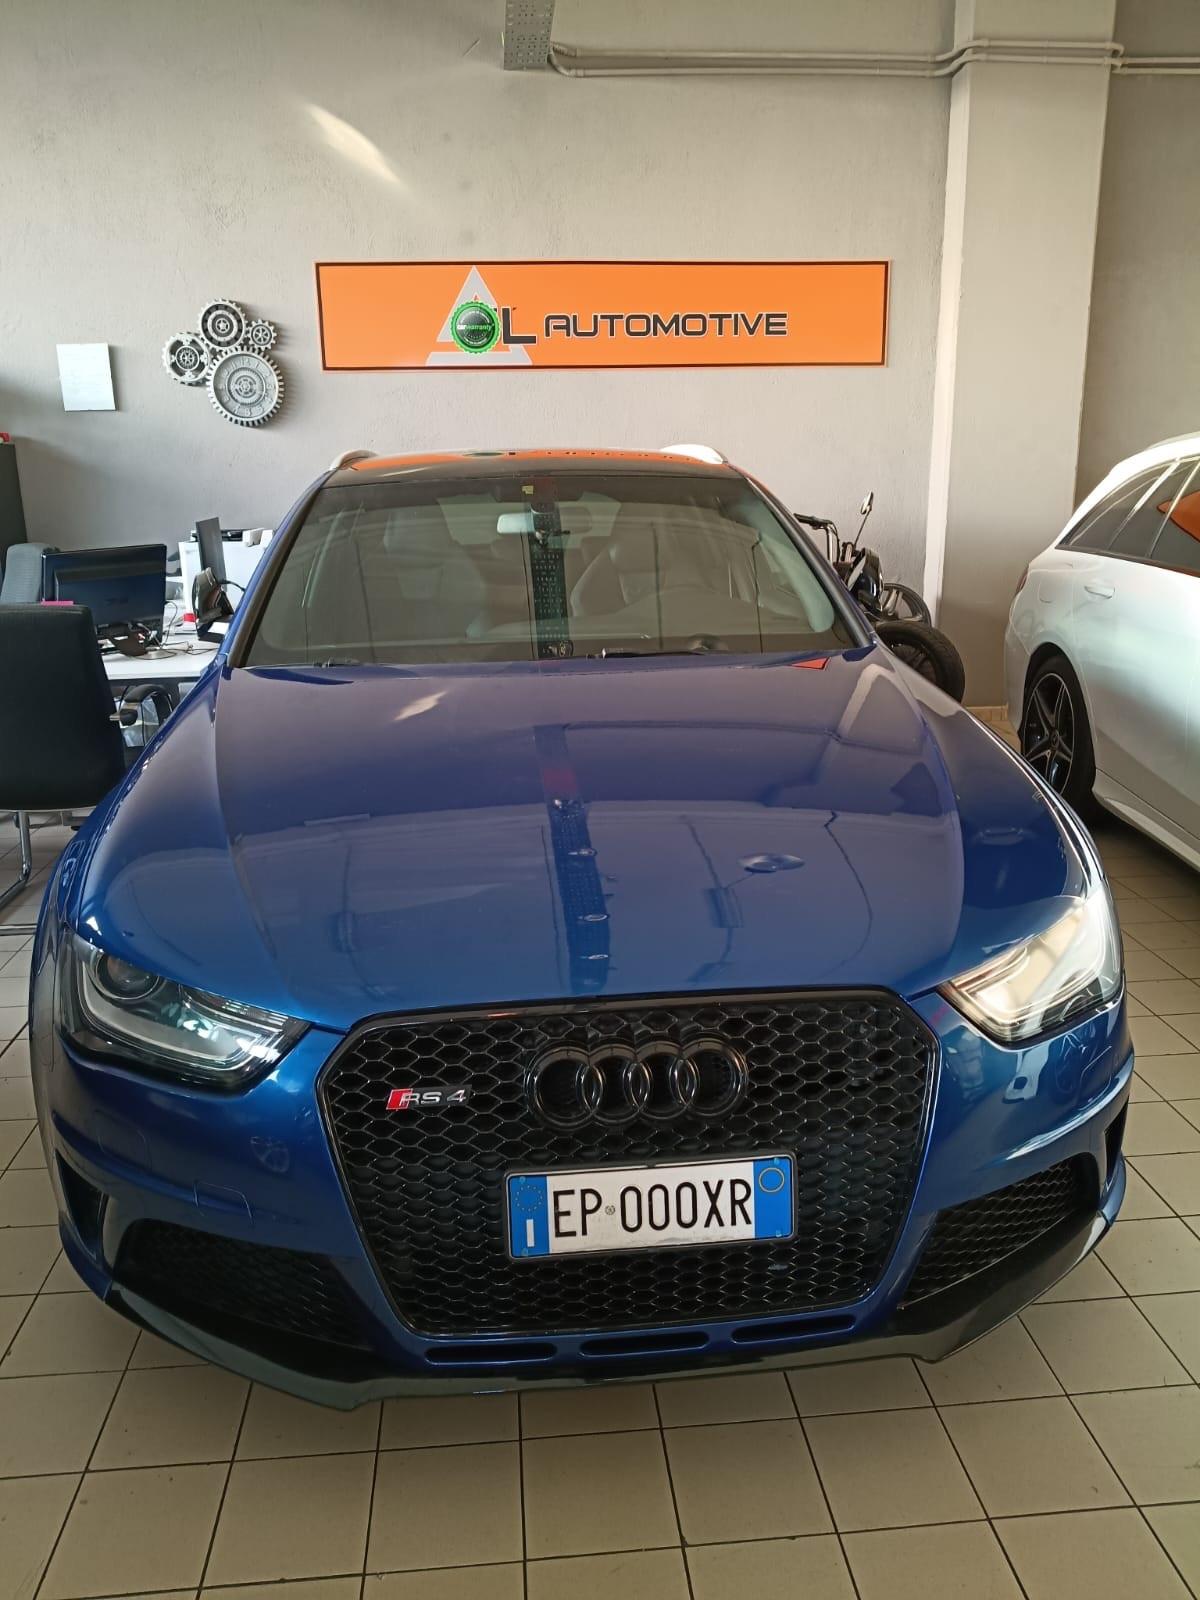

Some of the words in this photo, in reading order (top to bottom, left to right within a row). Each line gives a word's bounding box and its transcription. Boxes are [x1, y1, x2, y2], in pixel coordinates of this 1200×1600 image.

[544, 313, 788, 337] AUTOMOTIVE
[399, 1091, 442, 1105] RS
[446, 1089, 466, 1103] 4
[553, 1188, 601, 1238] EP
